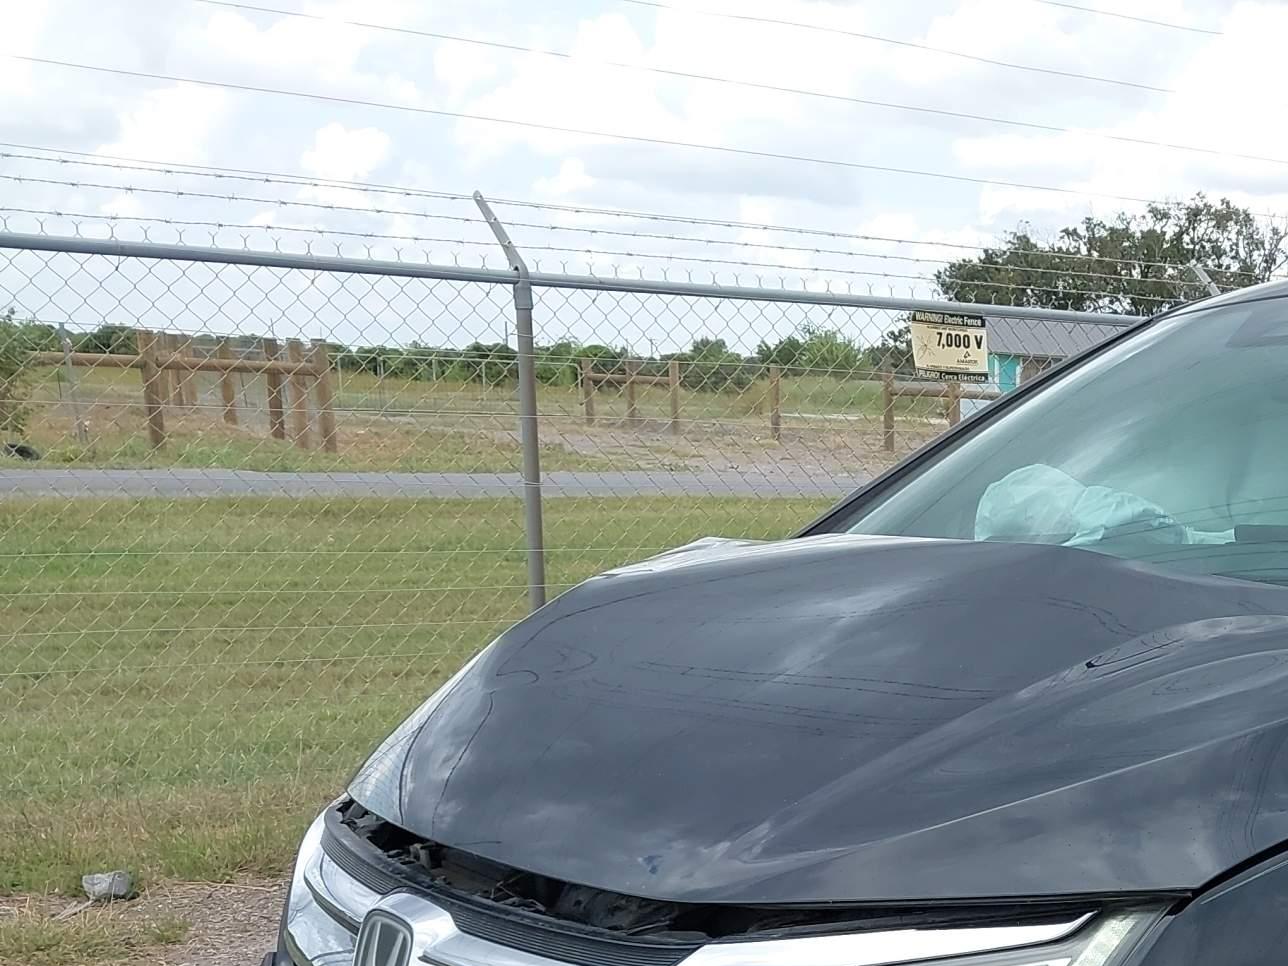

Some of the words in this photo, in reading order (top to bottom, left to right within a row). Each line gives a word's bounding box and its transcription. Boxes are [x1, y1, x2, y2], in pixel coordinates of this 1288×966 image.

[963, 316, 982, 327] Fence
[936, 332, 970, 349] 7,000
[974, 335, 983, 349] V
